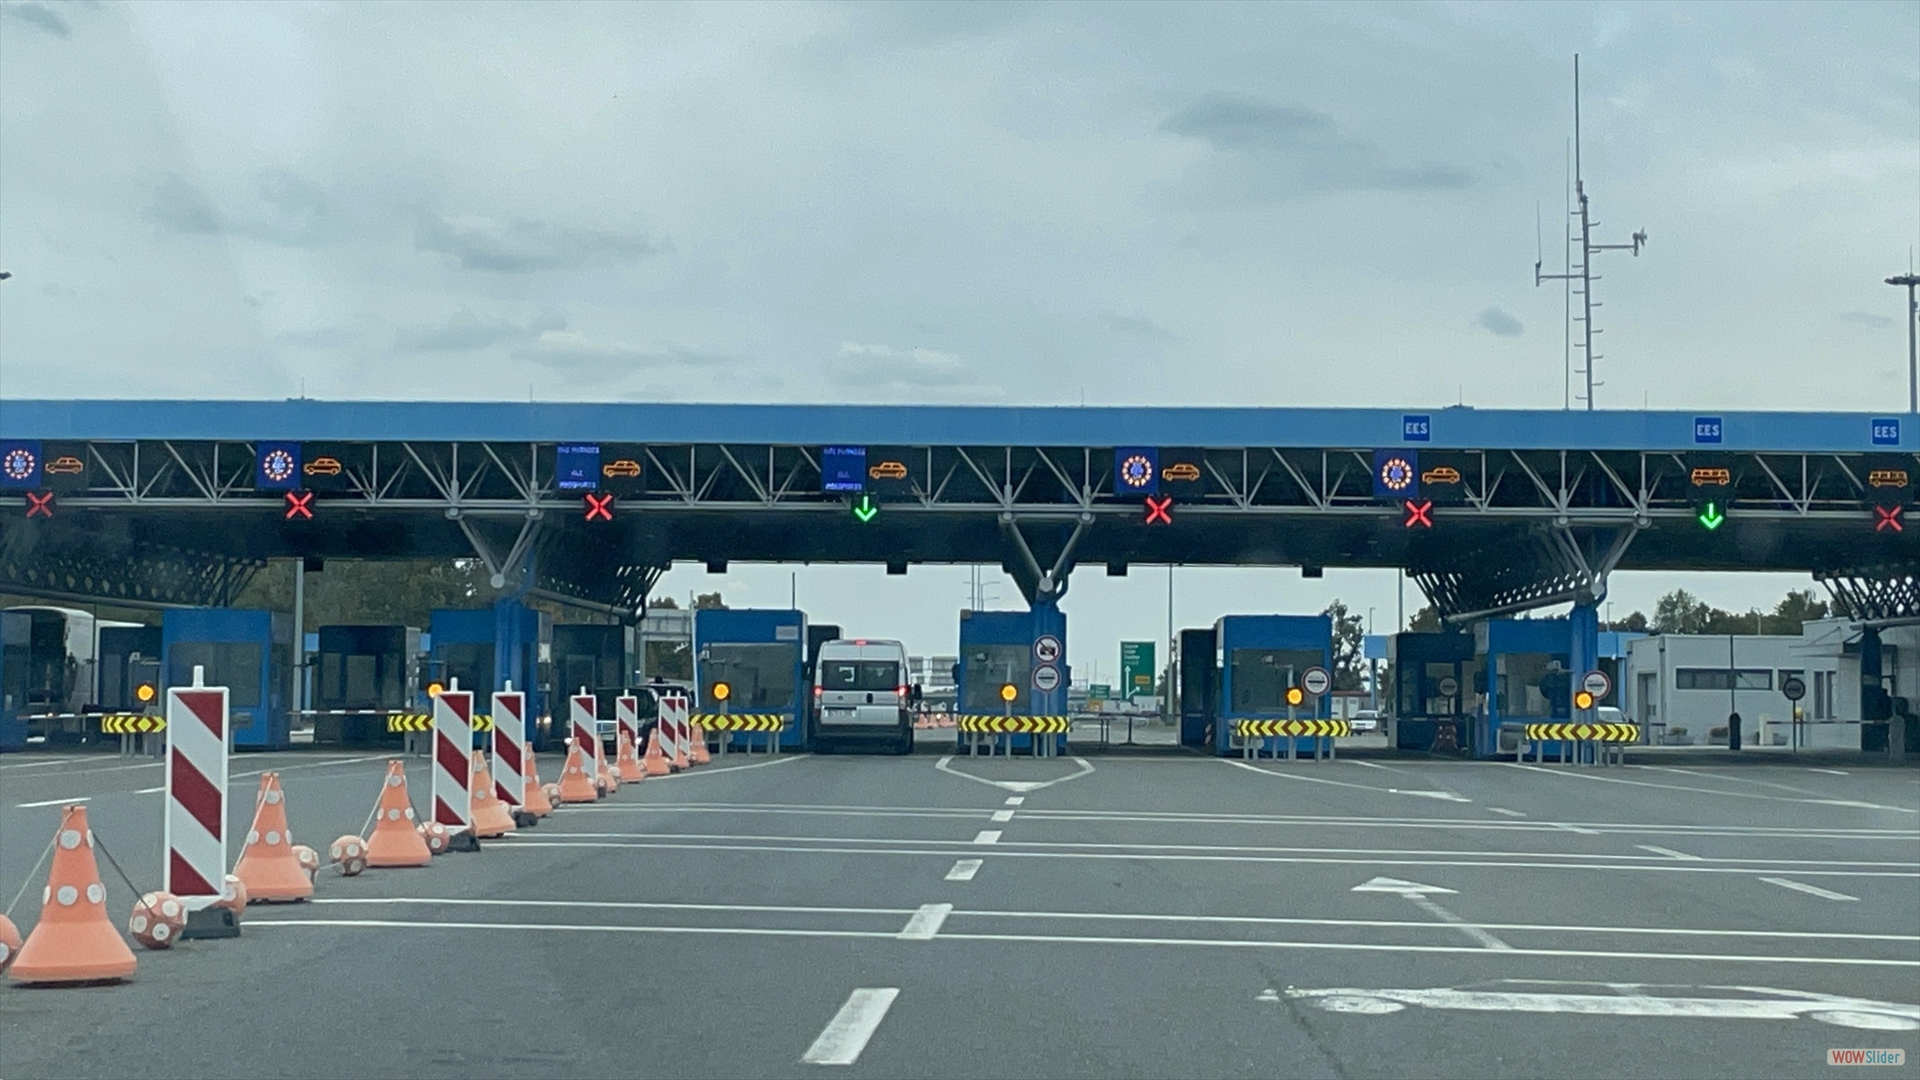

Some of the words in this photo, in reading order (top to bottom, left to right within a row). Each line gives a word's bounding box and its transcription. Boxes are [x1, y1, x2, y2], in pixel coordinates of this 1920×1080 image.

[1405, 422, 1428, 435] EES
[1696, 424, 1720, 437] EES
[1874, 425, 1897, 438] EES
